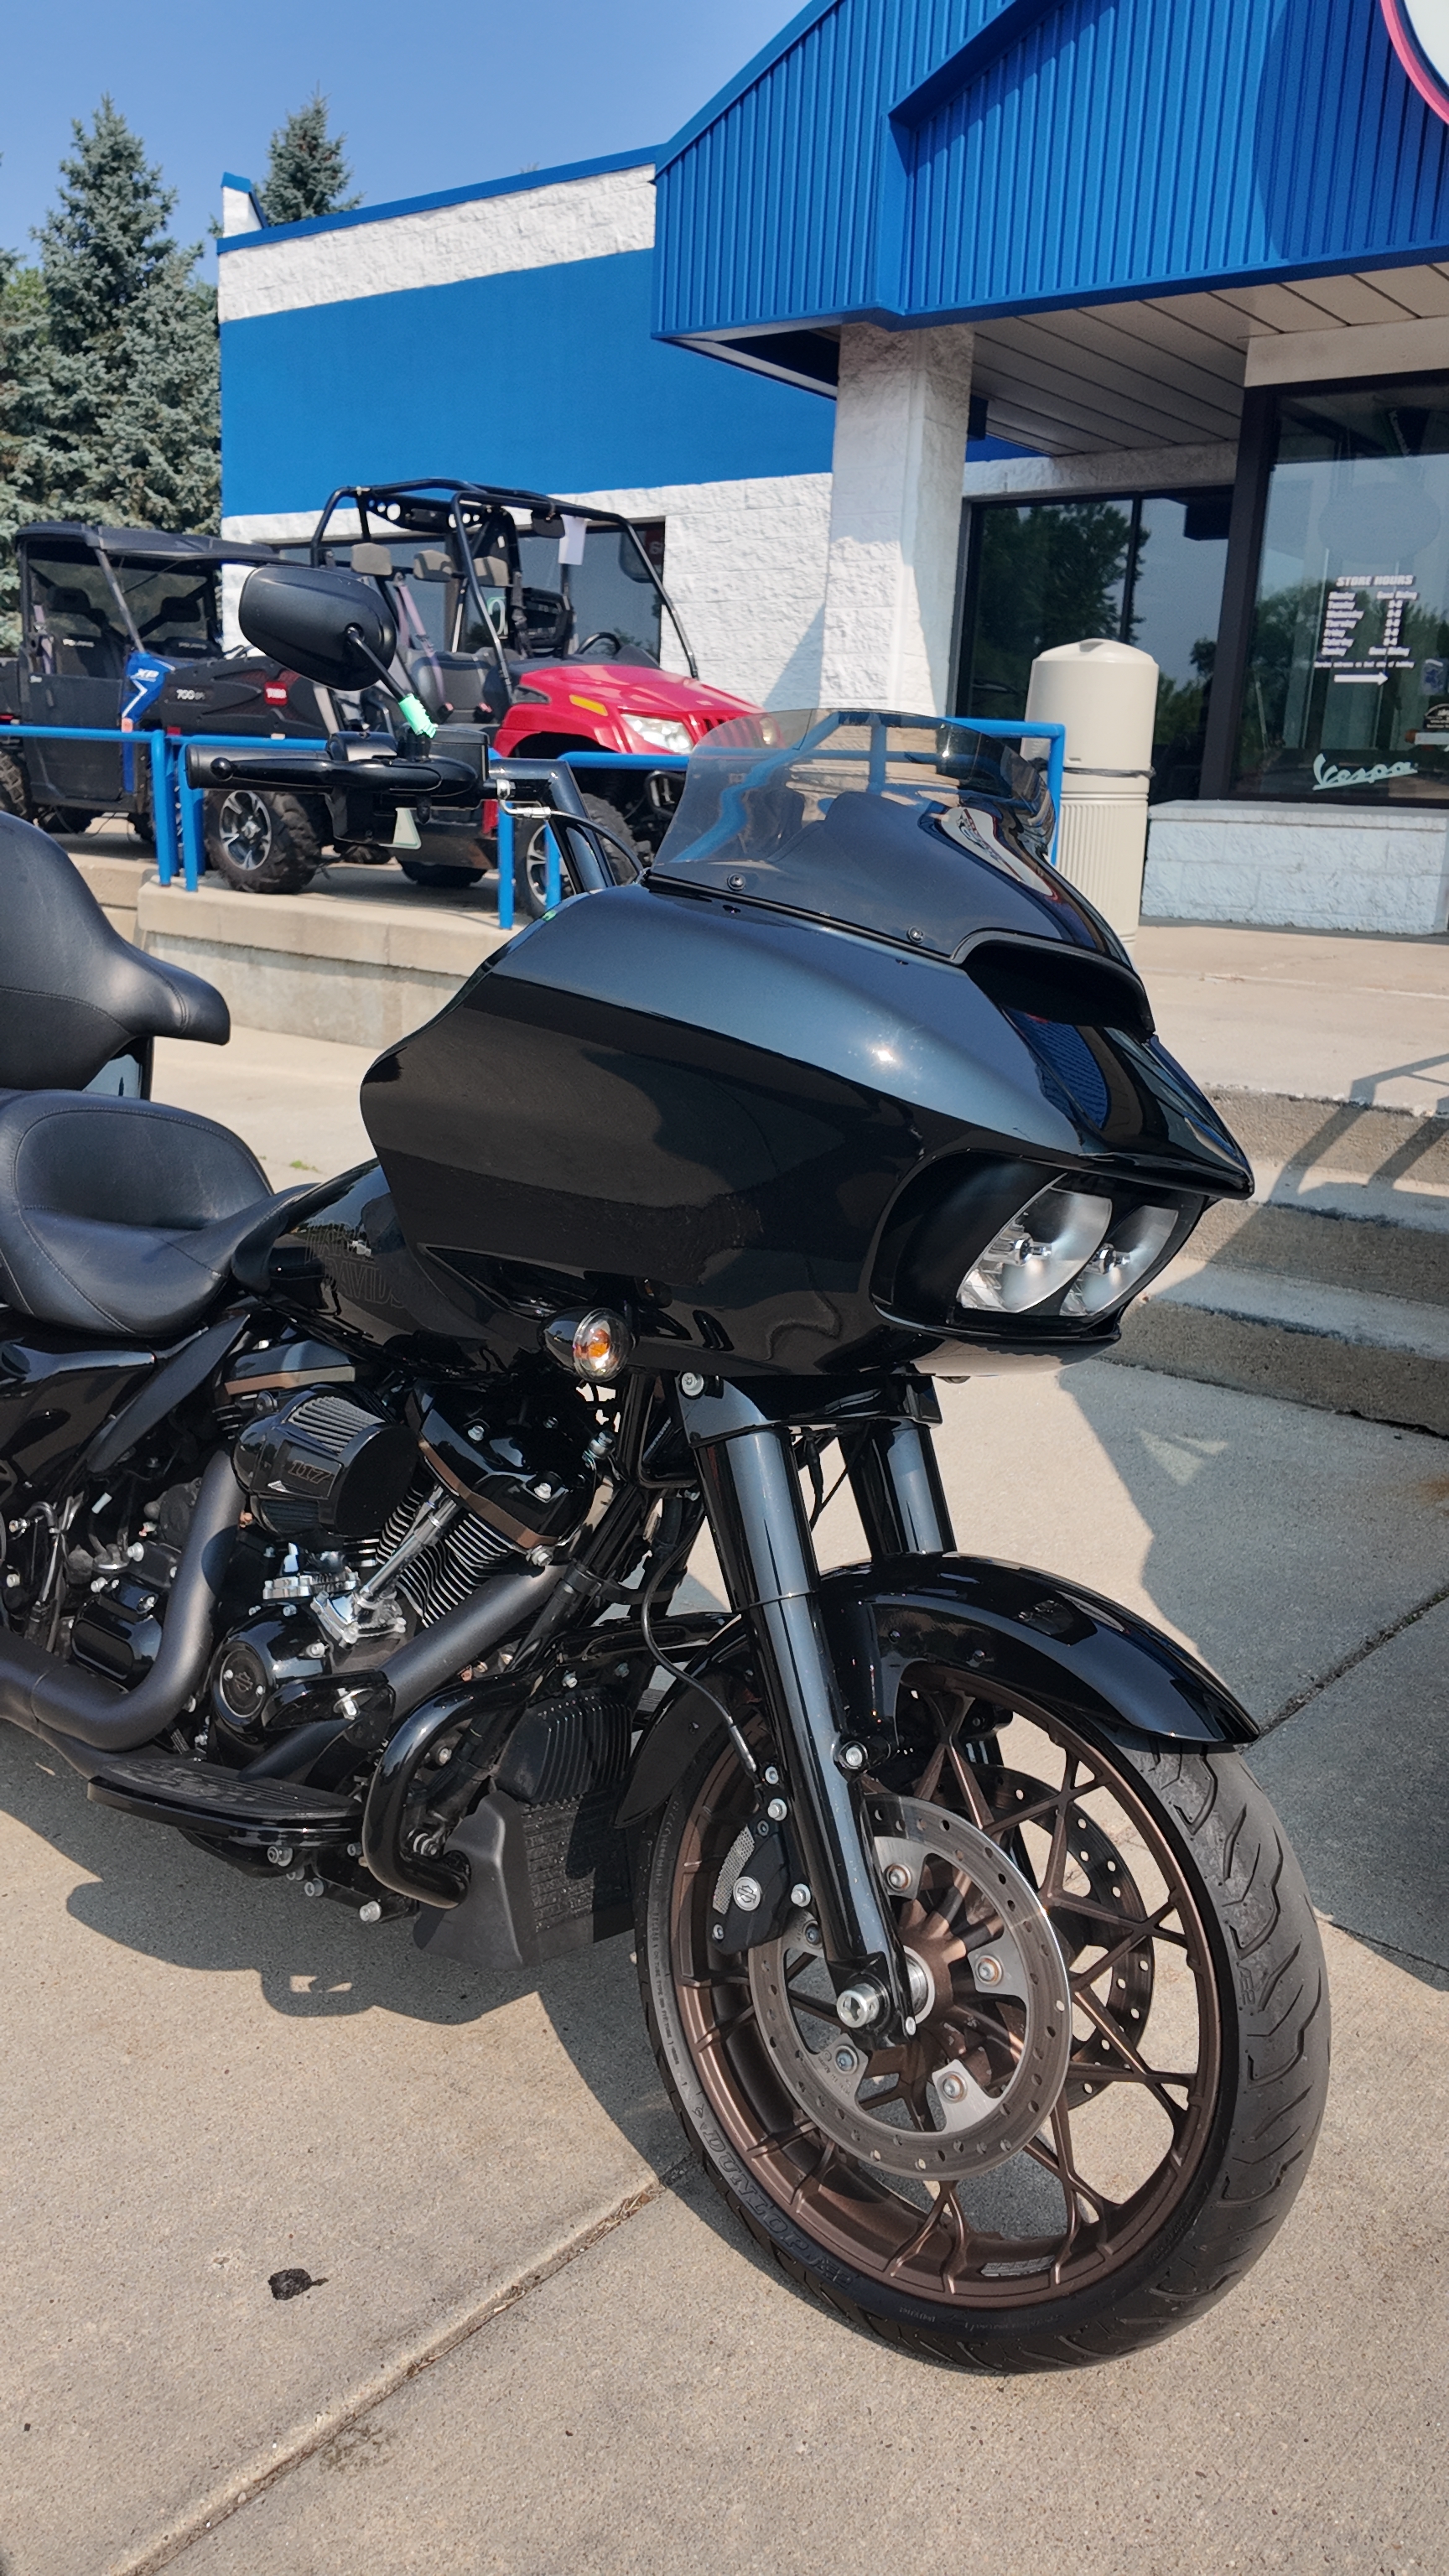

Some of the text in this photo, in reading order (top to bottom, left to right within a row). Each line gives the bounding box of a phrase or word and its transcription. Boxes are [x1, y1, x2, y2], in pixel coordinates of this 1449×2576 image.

[1336, 574, 1415, 588] STORE HOURS
[1326, 620, 1357, 629] Thursday
[1323, 629, 1346, 638] Friday
[1322, 638, 1354, 647] Saturday
[137, 667, 159, 678] XP
[1311, 752, 1419, 792] Vespa
[288, 1459, 332, 1484] 117
[702, 2128, 810, 2261] DUNLOP
